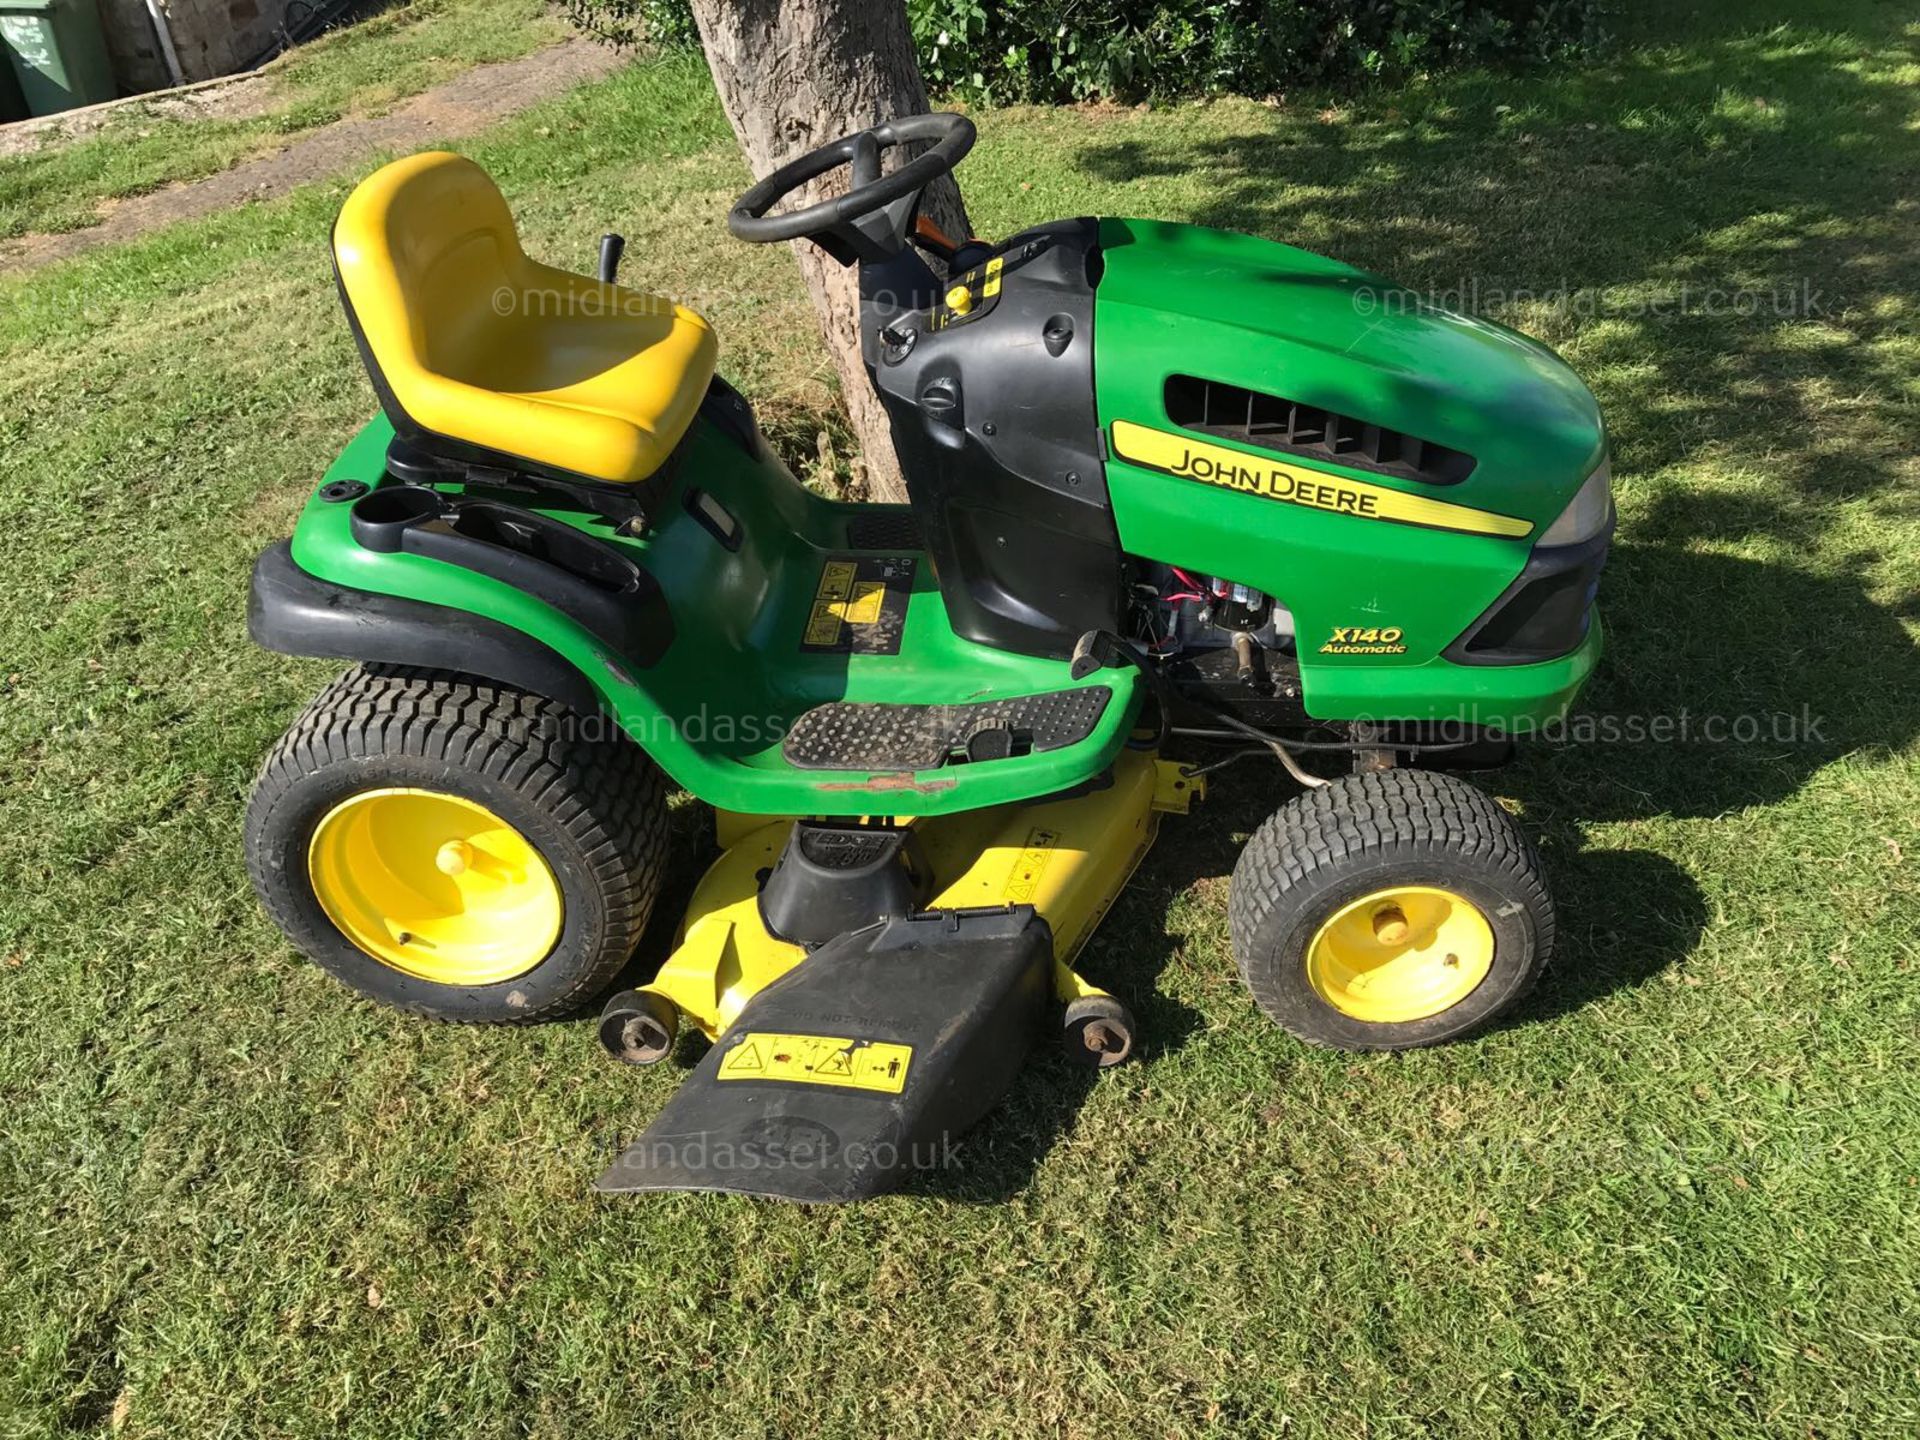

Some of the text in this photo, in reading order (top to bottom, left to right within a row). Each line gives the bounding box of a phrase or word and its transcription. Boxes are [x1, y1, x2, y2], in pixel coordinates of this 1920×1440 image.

[1171, 450, 1379, 515] JOHN DEERE
[1329, 627, 1403, 643] X140
[1319, 644, 1407, 654] Automatic
